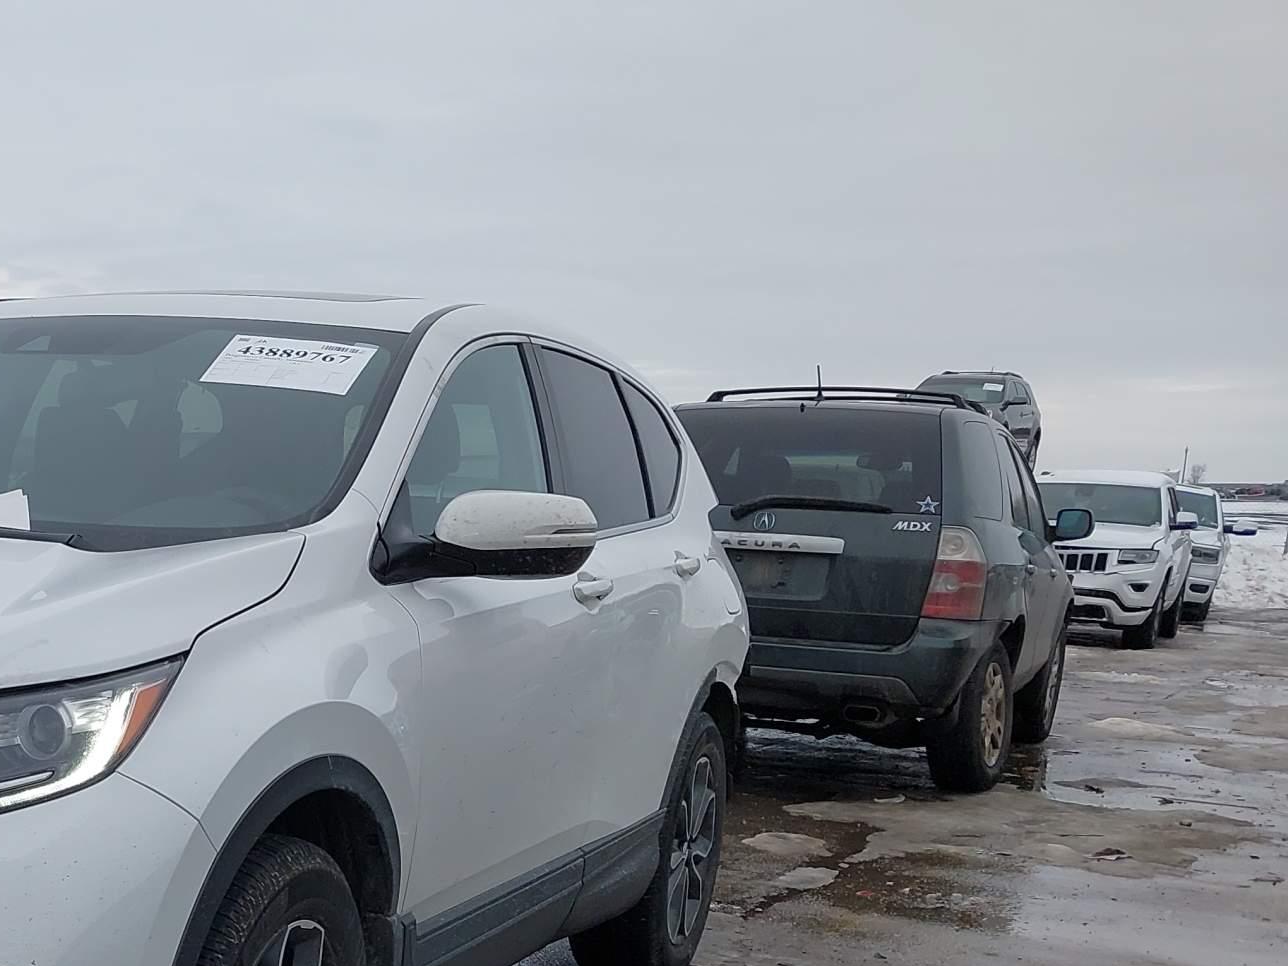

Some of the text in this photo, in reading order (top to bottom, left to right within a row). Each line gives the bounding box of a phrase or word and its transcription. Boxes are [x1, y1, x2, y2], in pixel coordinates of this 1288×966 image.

[237, 345, 353, 364] 43889767
[891, 520, 933, 532] MDX
[719, 538, 801, 550] ACURA
